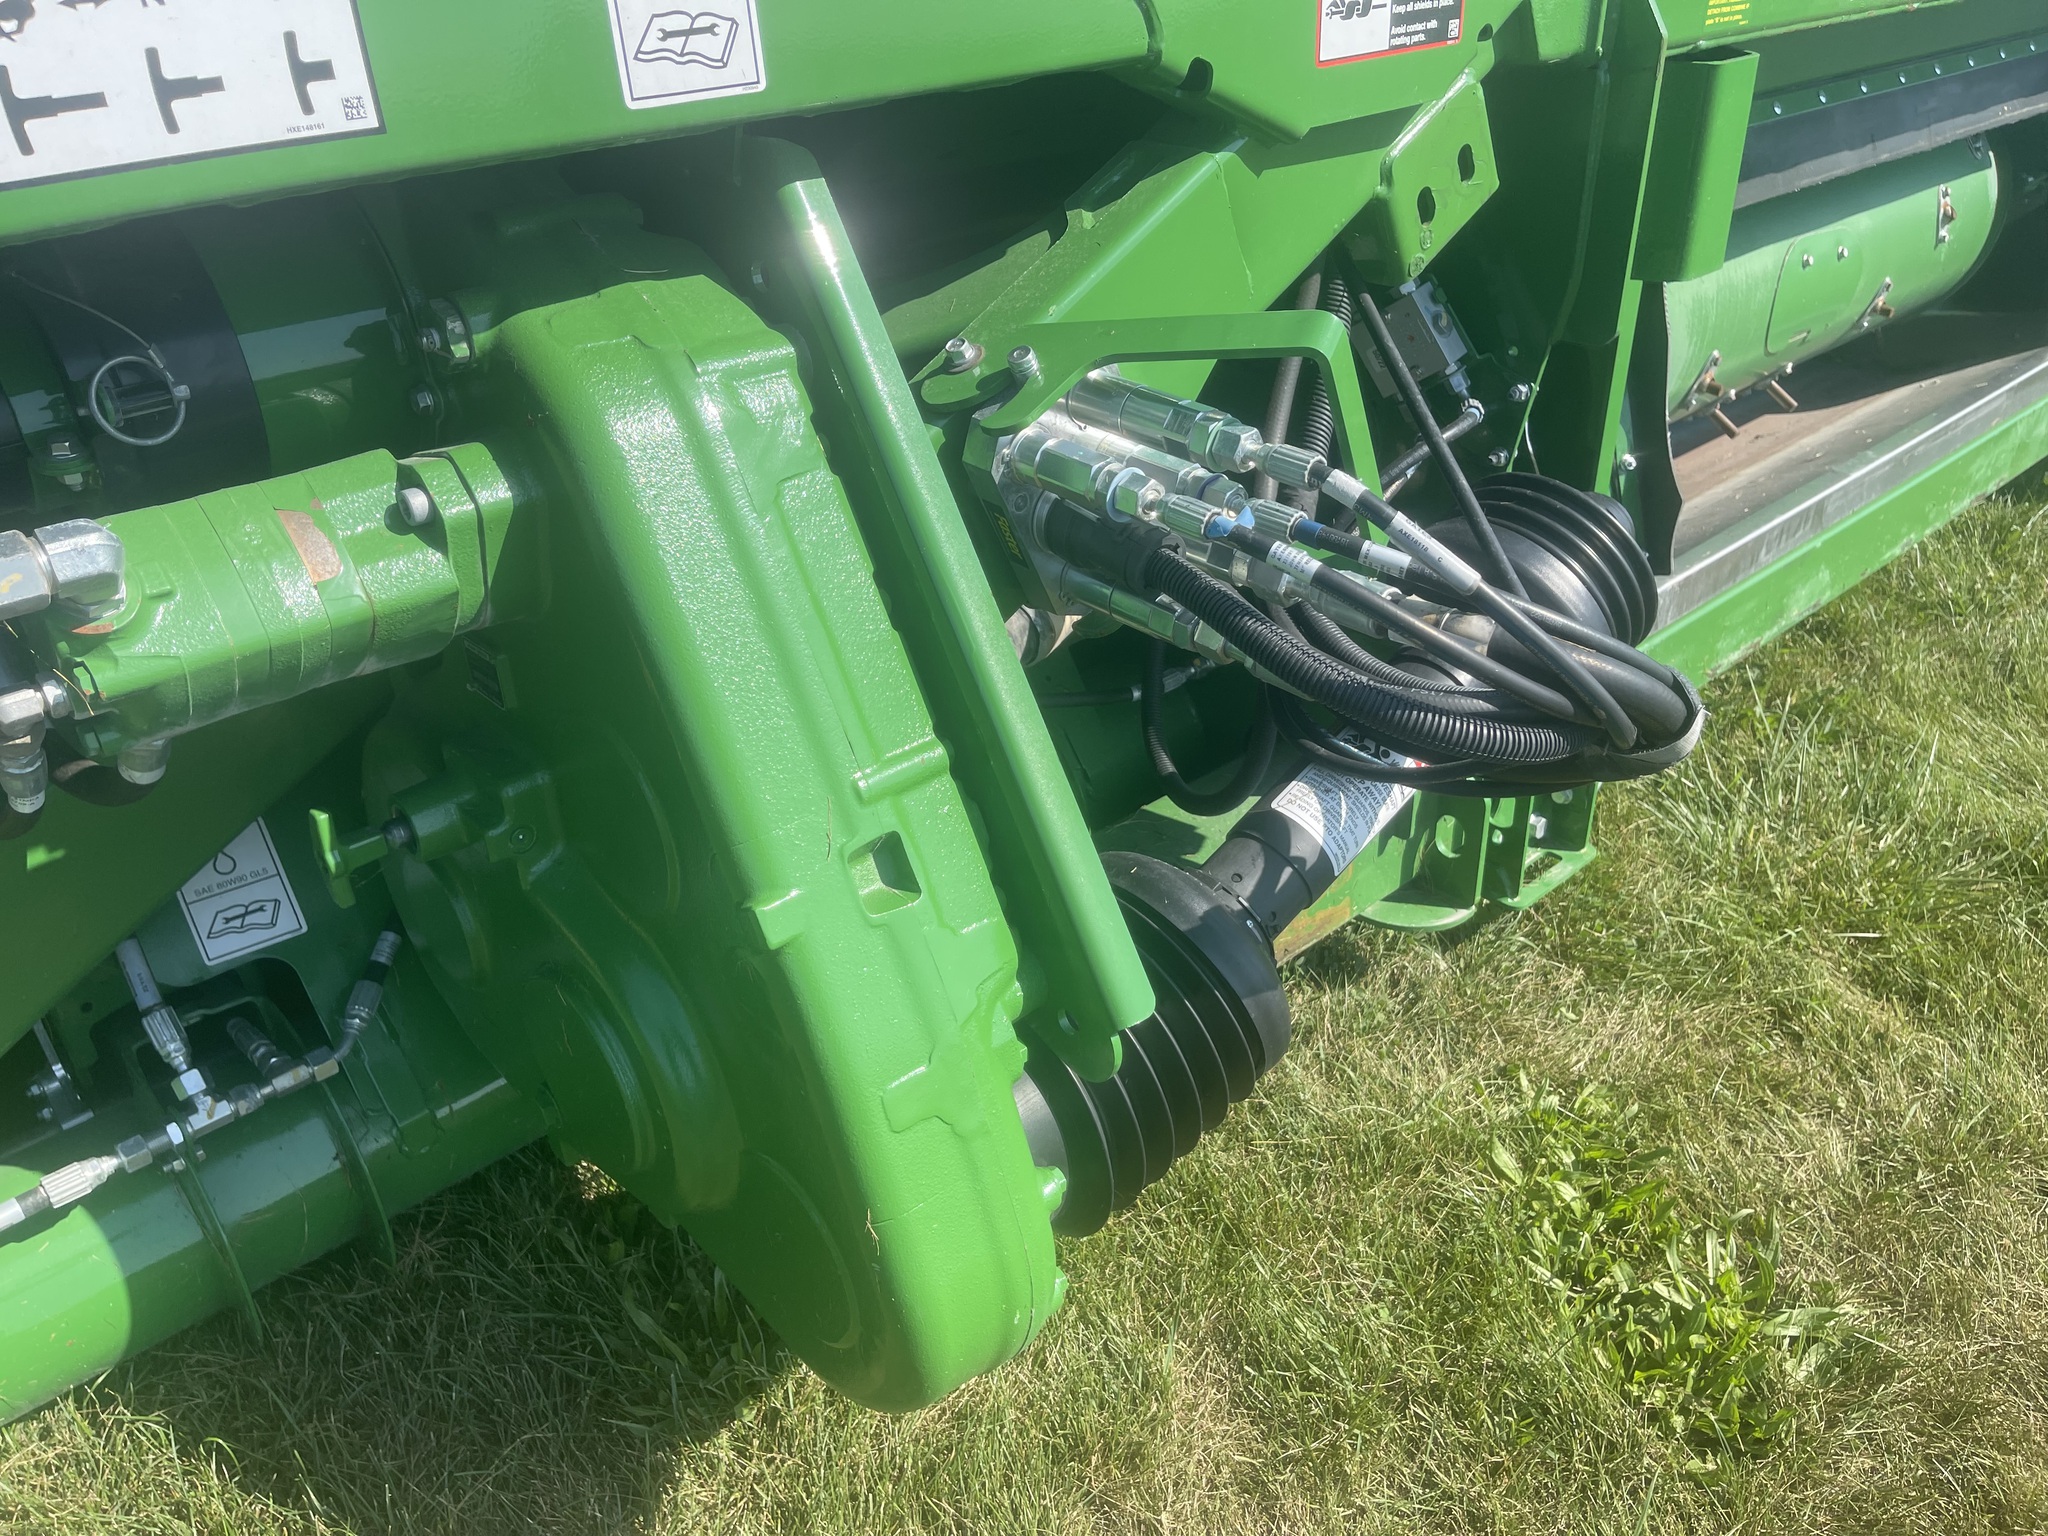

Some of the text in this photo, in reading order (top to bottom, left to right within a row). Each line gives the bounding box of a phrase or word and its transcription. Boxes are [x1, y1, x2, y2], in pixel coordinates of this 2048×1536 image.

[1392, 3, 1406, 14] Keep
[1414, 0, 1432, 10] shields
[1391, 19, 1437, 35] Avoid contact with
[1390, 33, 1426, 45] rotating parts.
[286, 122, 325, 134] HXE148161
[1326, 772, 1355, 796] DRIVESHAFT
[1345, 777, 1370, 802] OPERATE
[1323, 777, 1352, 801] EQUIPMENT
[1351, 800, 1366, 821] SHIELDS
[1362, 785, 1382, 809] AWAY!
[1346, 824, 1355, 836] THAT
[1347, 815, 1358, 829] ENDS
[1296, 803, 1310, 814] NOT
[1310, 812, 1323, 825] USE
[1331, 835, 1347, 863] ADAPTORS
[194, 885, 215, 898] SAE
[249, 867, 269, 878] GL5
